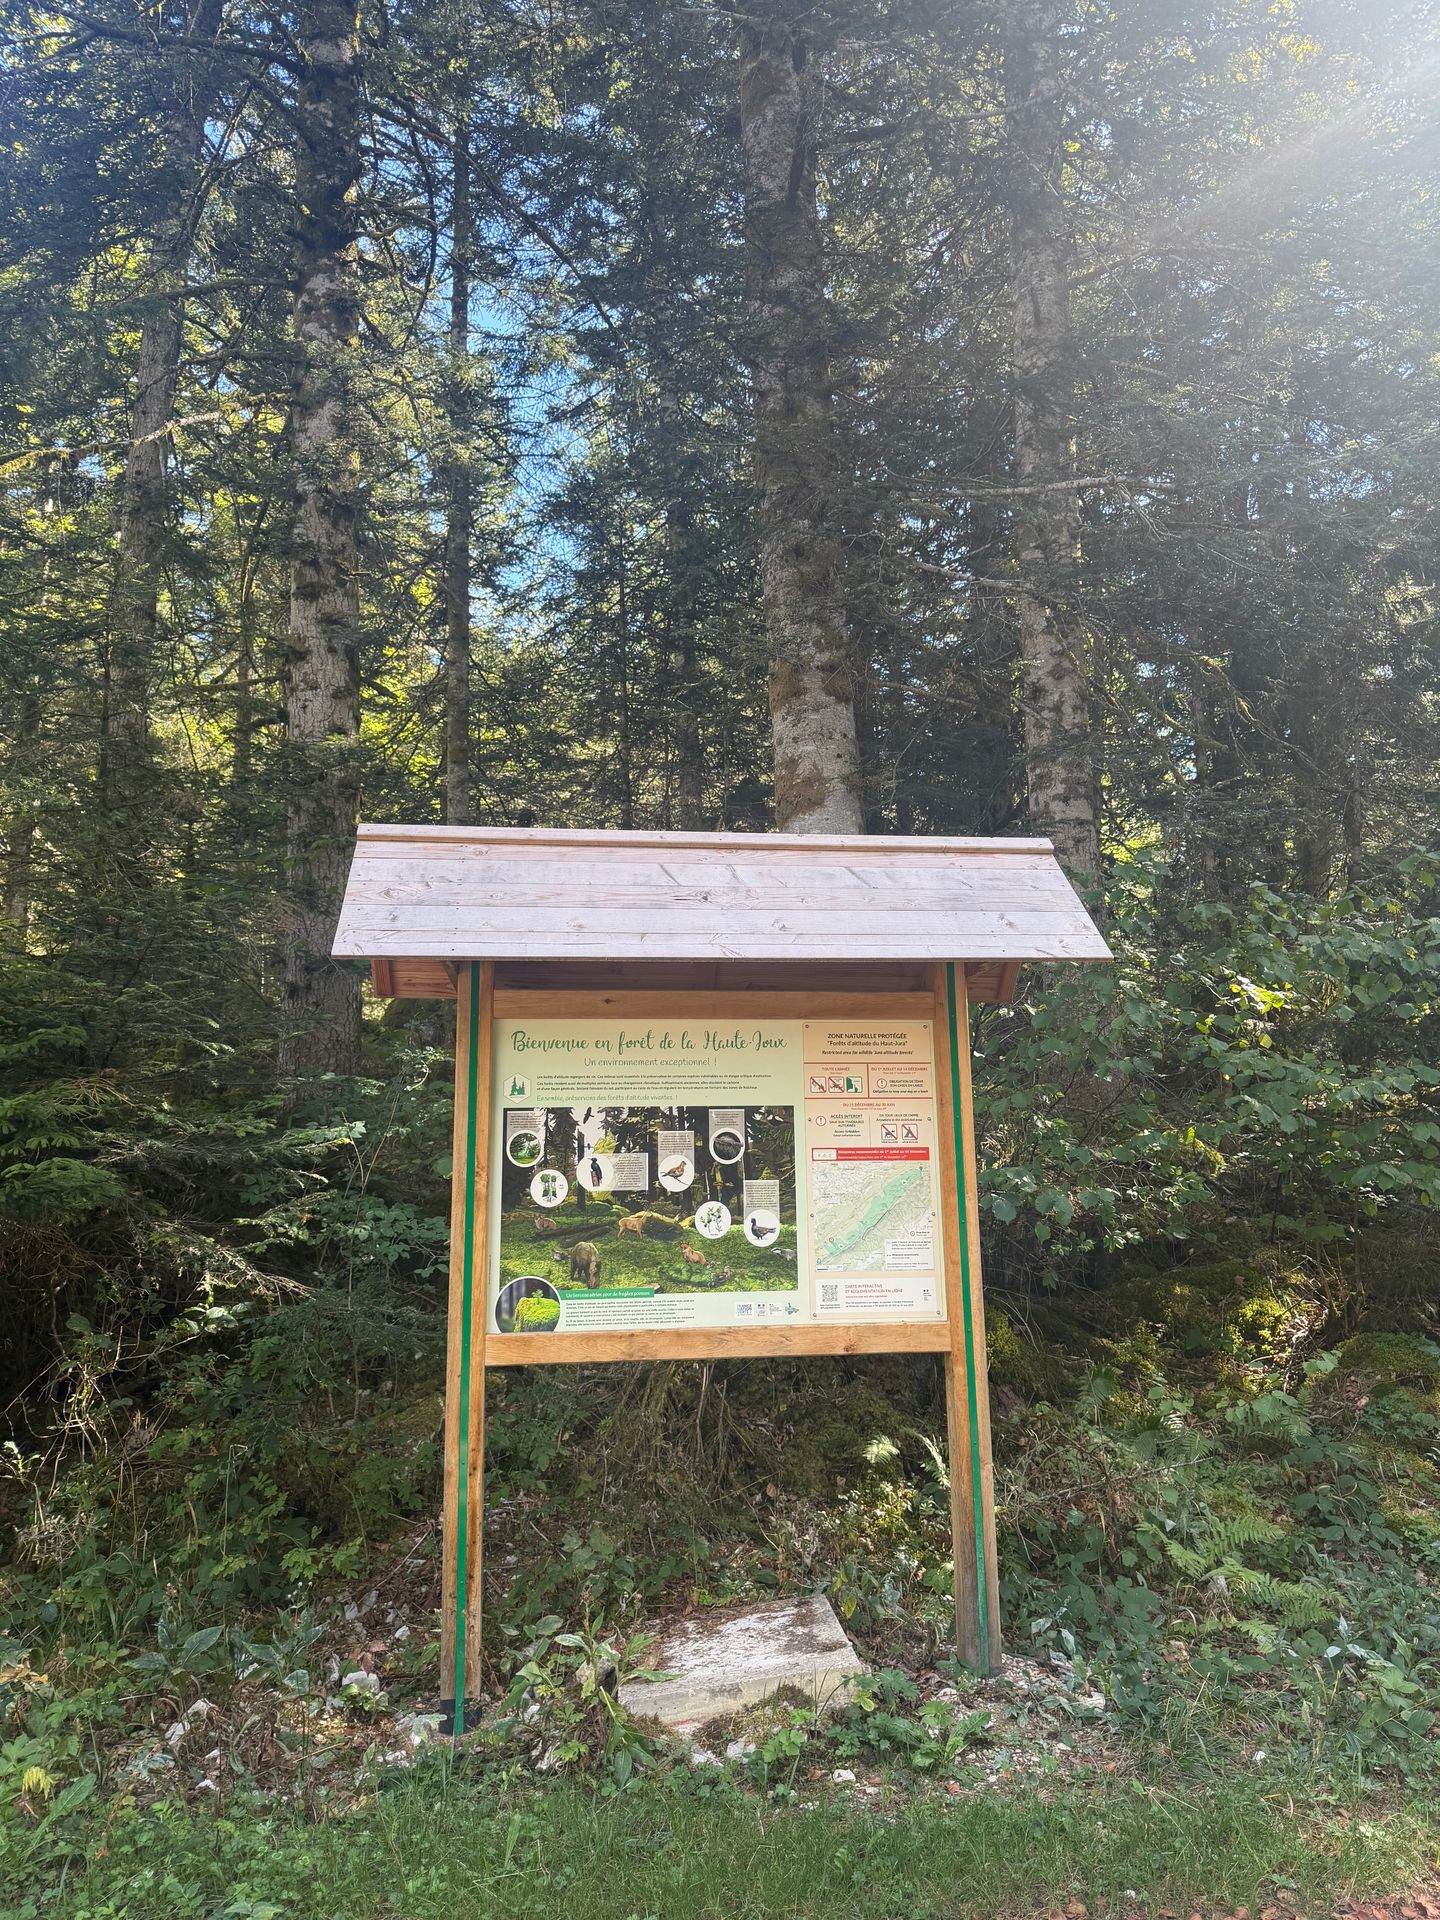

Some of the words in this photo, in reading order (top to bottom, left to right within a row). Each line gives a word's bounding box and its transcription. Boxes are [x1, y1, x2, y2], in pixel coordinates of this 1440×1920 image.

[511, 1030, 590, 1052] Bienvenue
[594, 1039, 614, 1052] en
[618, 1030, 655, 1055] forêt
[660, 1032, 676, 1050] de
[681, 1031, 696, 1050] la
[703, 1030, 787, 1051] Haute-Joux
[584, 1058, 596, 1066] Un
[598, 1058, 658, 1066] environnement
[660, 1058, 710, 1067] exceptionnel
